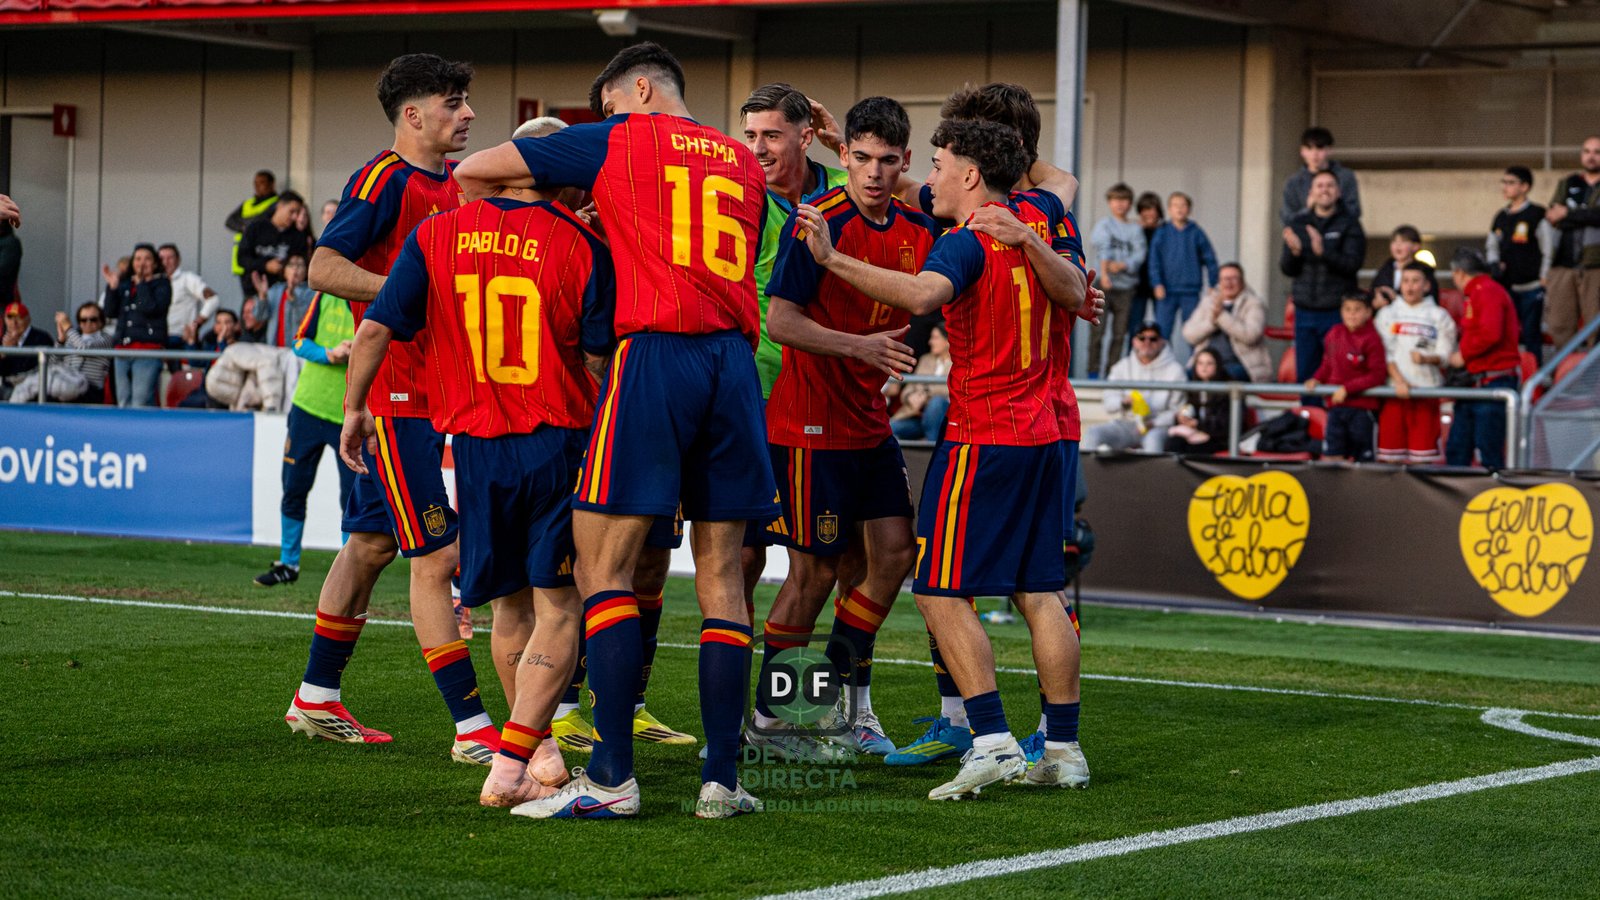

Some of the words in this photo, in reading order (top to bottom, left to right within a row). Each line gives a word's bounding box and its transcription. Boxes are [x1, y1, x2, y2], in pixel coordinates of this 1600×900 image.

[671, 133, 739, 167] CHEMA
[664, 165, 747, 282] 16
[457, 231, 519, 257] PABLO
[522, 238, 540, 262] G.
[455, 273, 541, 385] 10
[0, 434, 147, 489] ovistar
[1194, 483, 1305, 526] tierra
[1466, 495, 1588, 540] tierra
[1201, 519, 1236, 542] de
[1207, 520, 1306, 578] sabor
[1474, 534, 1512, 558] de
[1481, 534, 1589, 595] sabor
